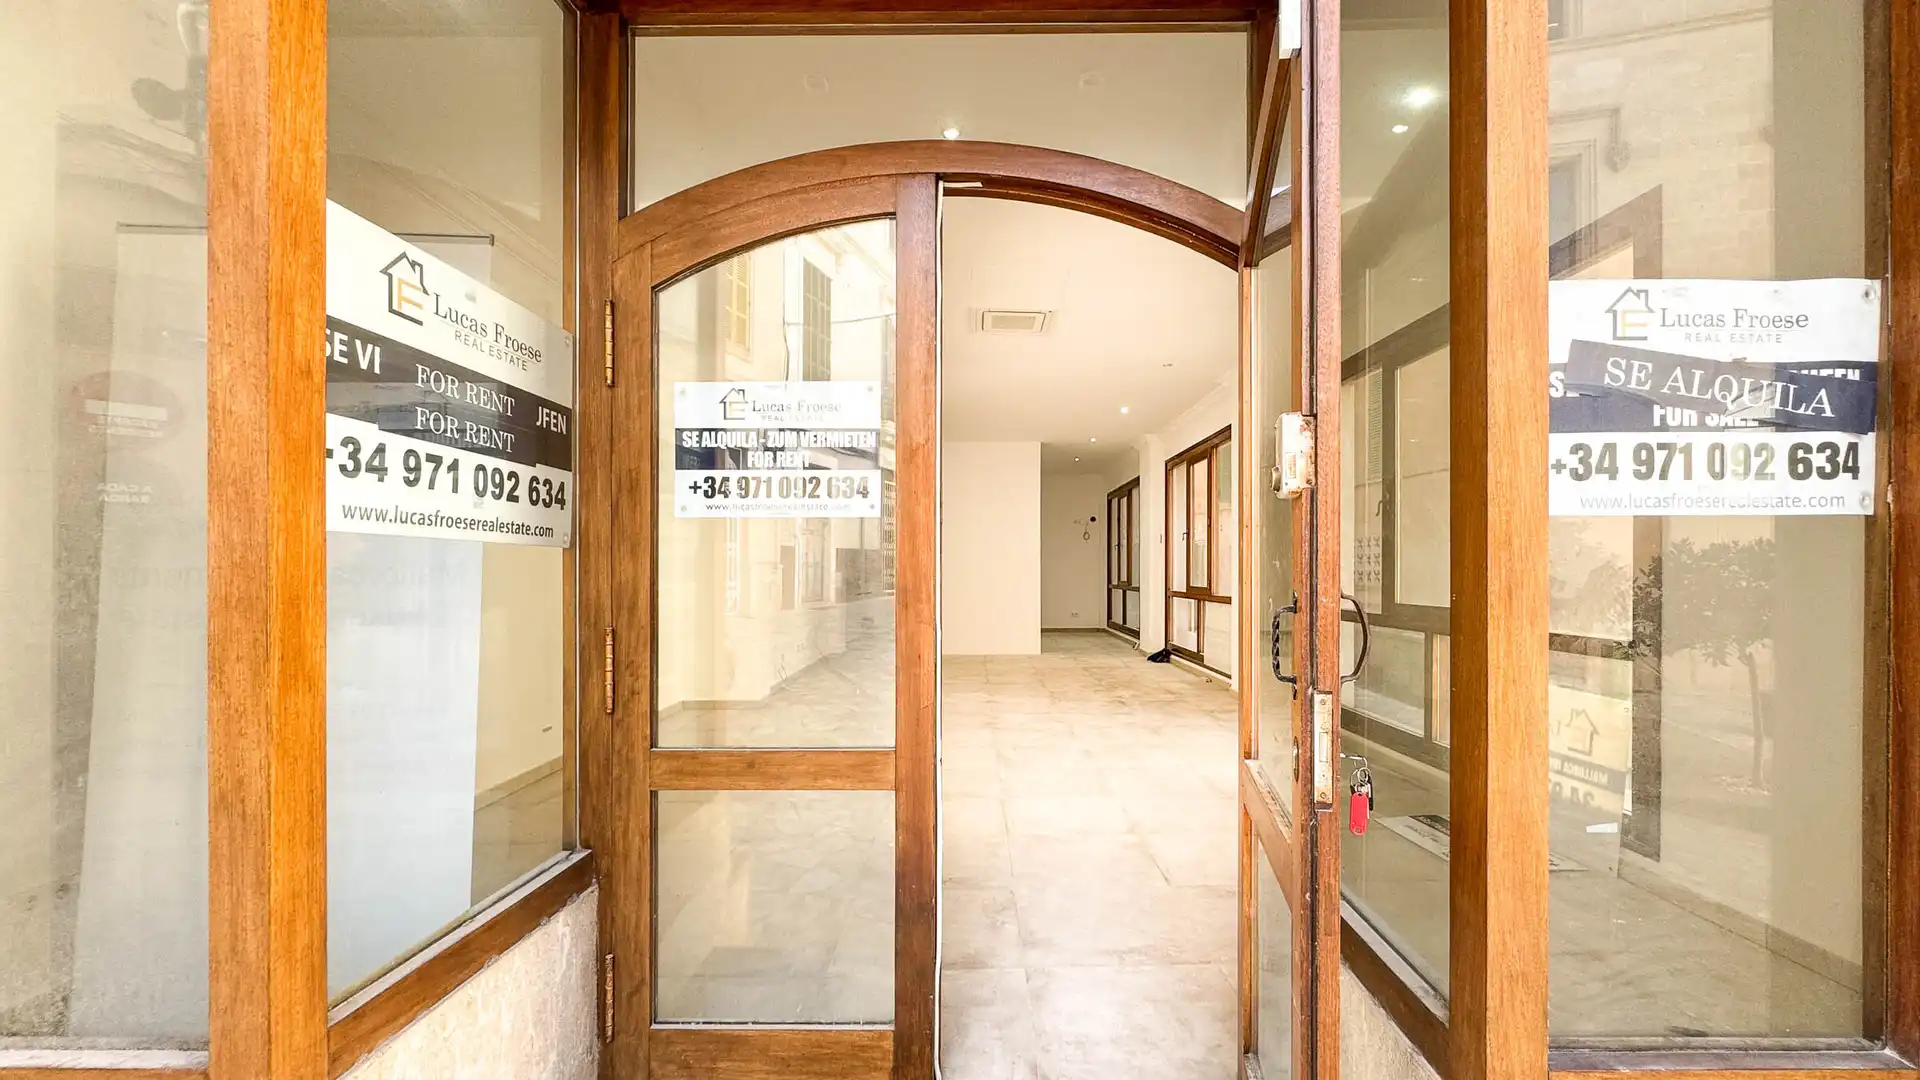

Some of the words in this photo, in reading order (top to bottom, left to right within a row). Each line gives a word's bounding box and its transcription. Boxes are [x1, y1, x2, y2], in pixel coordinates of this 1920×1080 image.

[433, 292, 488, 339] Lucas
[494, 322, 542, 363] Froese
[1660, 308, 1726, 329] Lucas
[1733, 308, 1809, 329] Froese
[455, 330, 485, 353] REAL
[489, 345, 528, 372] ESTATE
[1685, 333, 1721, 344] REAL
[1730, 333, 1783, 344] ESTATE
[415, 363, 460, 399] FOR
[465, 381, 516, 417] RENT
[1604, 356, 1653, 390] SE
[1660, 369, 1836, 418] ALQUILA
[752, 400, 791, 412] Lucas
[415, 406, 460, 439] FOR
[464, 423, 515, 454] RENT
[682, 431, 699, 448] SE
[701, 431, 758, 449] ALQUILA
[767, 431, 798, 448] ZUM
[799, 431, 876, 448] VERMIETEN
[748, 451, 774, 468] FOR
[776, 451, 810, 468] RENT
[1551, 442, 1619, 481] +34
[1632, 442, 1693, 481] 971
[1707, 442, 1776, 481] 092
[1788, 441, 1860, 481] 634
[402, 449, 460, 494] 971
[473, 463, 520, 503] 092
[528, 475, 567, 511] 634
[688, 476, 731, 499] +34
[737, 476, 772, 499] 971
[778, 476, 821, 499] 092
[826, 476, 869, 499] 634
[342, 504, 554, 538] www.lucasfroeserealestate.com
